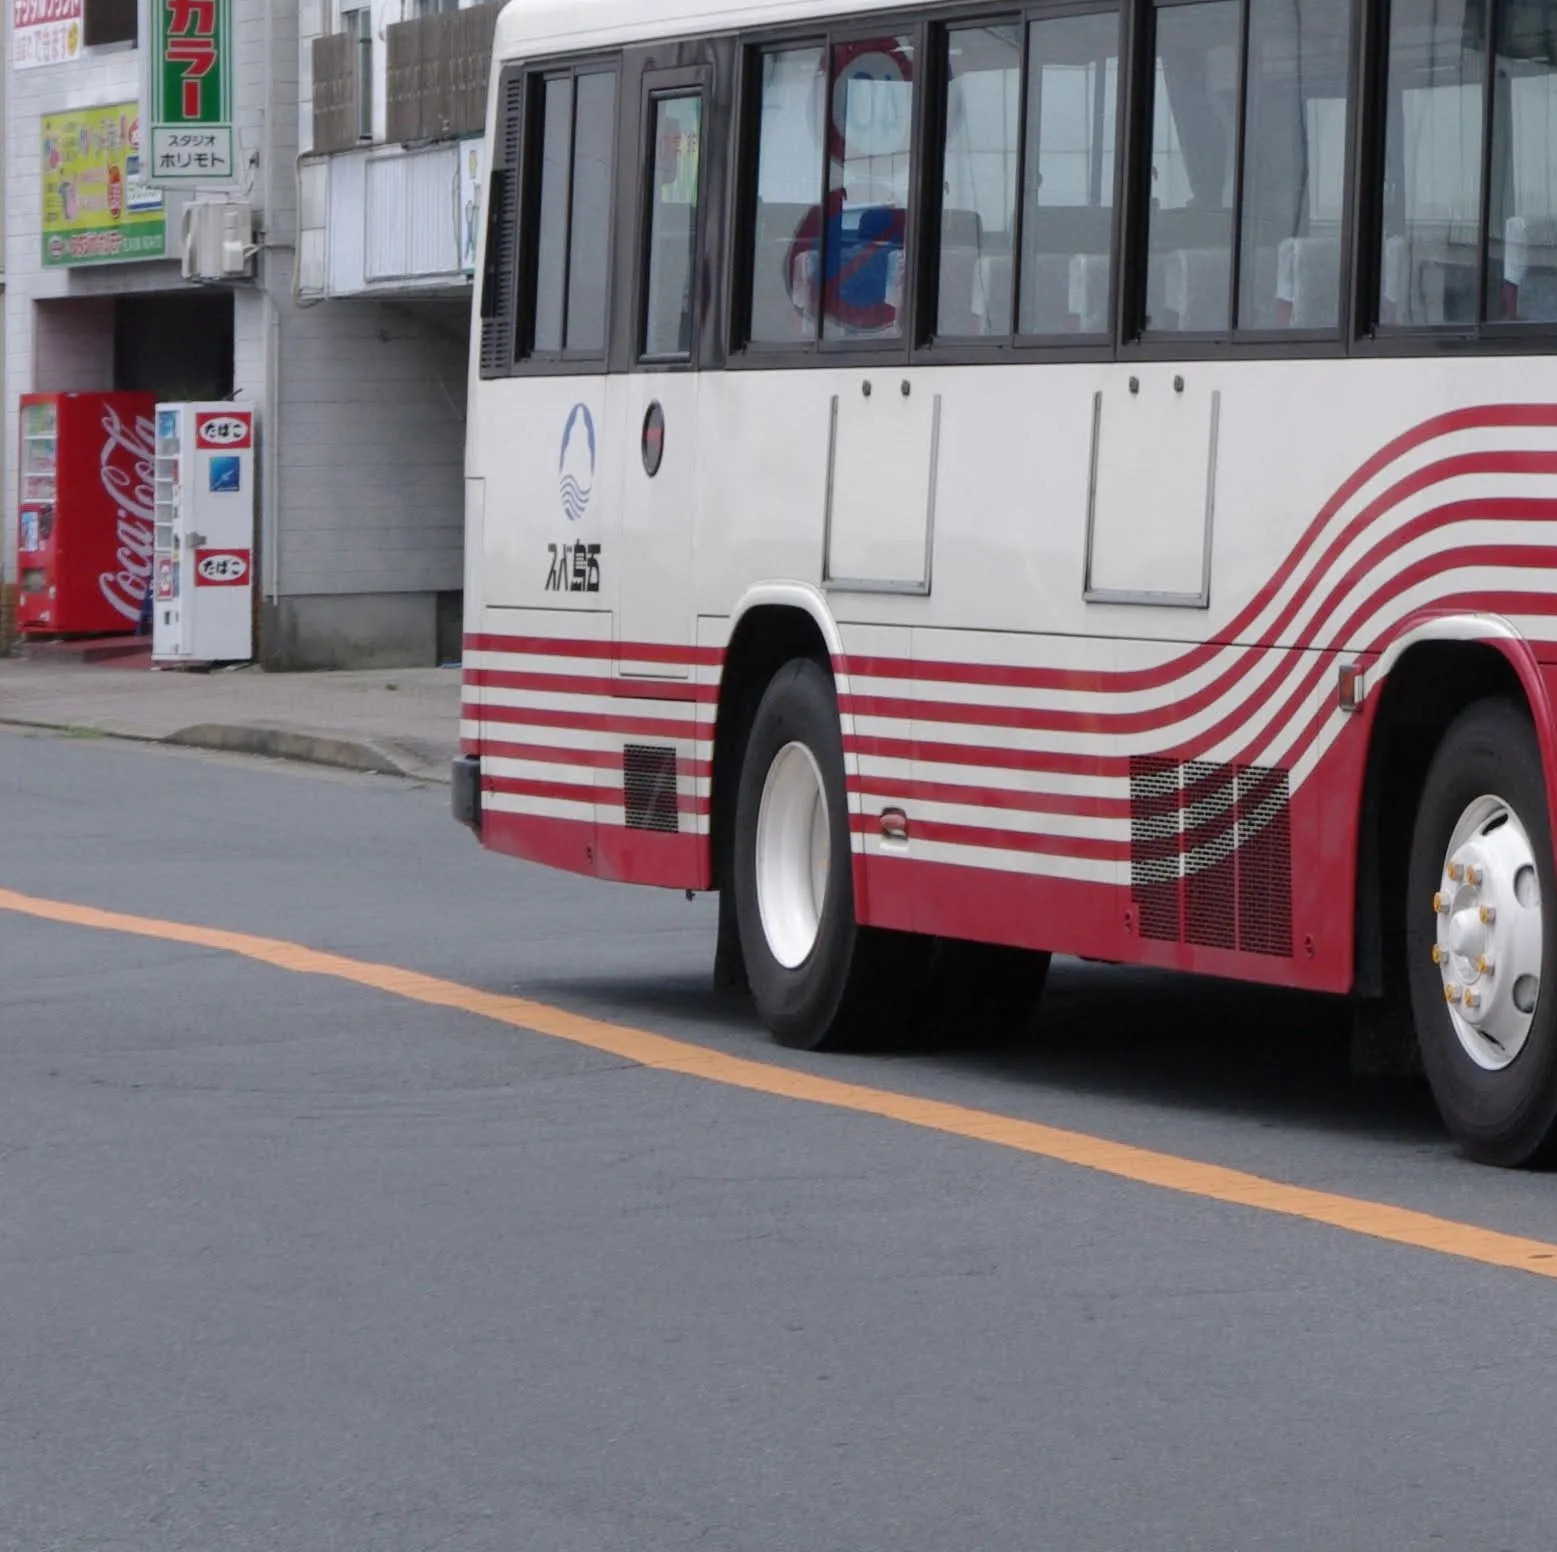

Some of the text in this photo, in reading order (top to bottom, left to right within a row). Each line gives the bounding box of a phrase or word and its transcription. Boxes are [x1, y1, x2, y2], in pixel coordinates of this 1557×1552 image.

[167, 133, 217, 148] スタジオ
[159, 148, 226, 169] ホリモト
[203, 422, 244, 440] たばこ
[202, 558, 241, 576] たばこ
